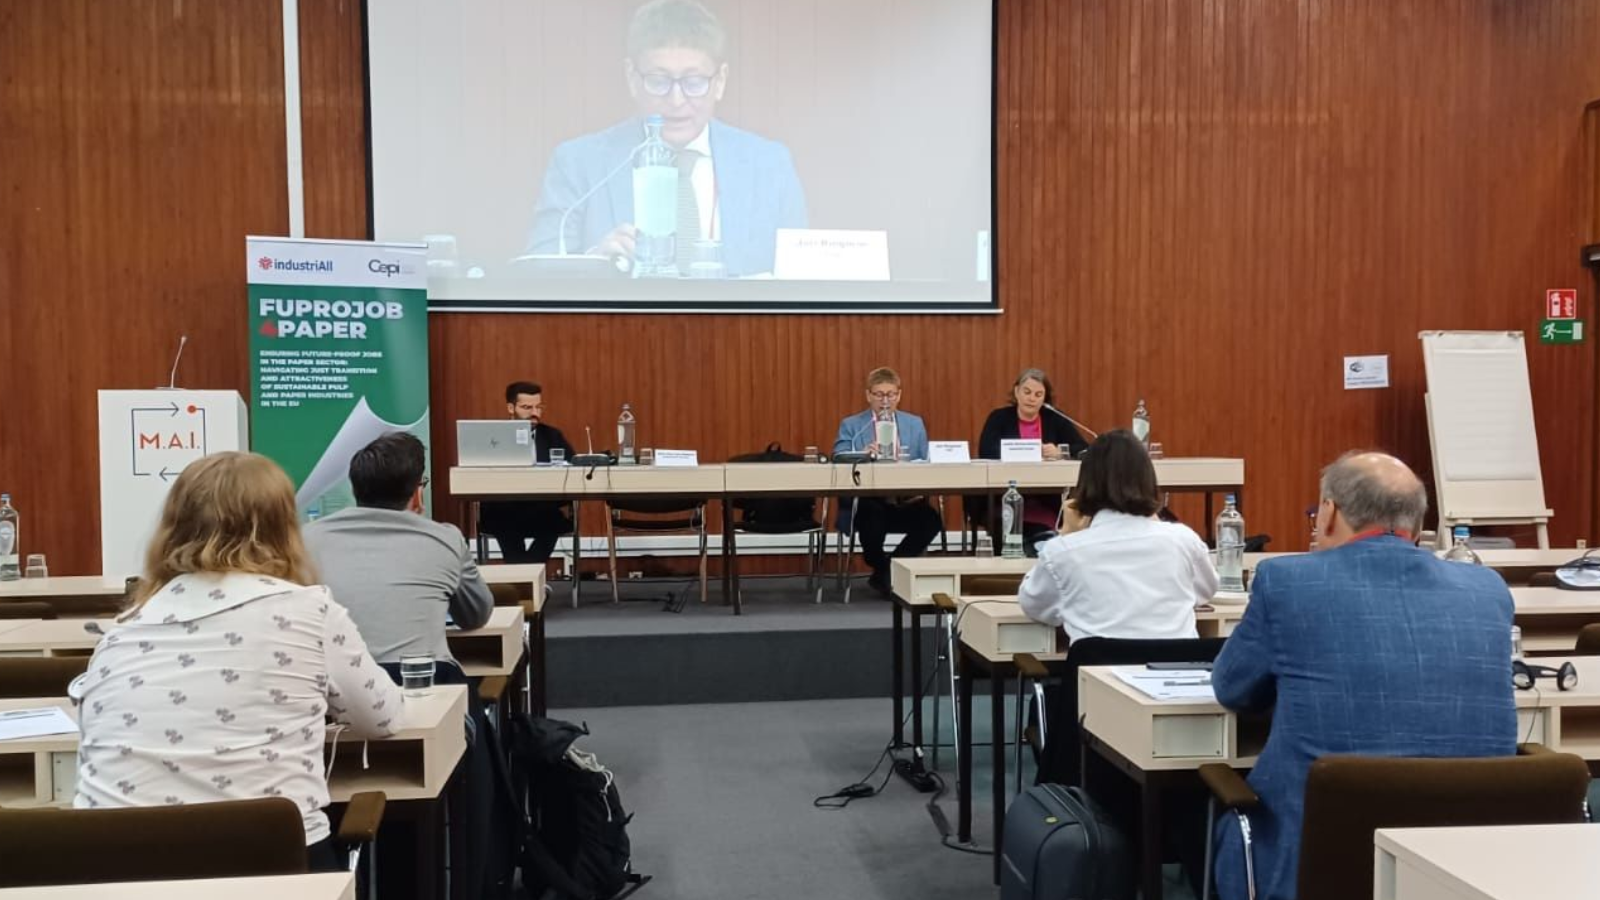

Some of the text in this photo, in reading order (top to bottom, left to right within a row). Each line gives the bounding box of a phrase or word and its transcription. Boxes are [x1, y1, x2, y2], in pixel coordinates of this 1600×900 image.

[274, 259, 333, 272] industriAll
[368, 259, 400, 278] Cepi
[259, 298, 404, 319] FUPROJOB
[140, 431, 201, 450] M.A.I.
